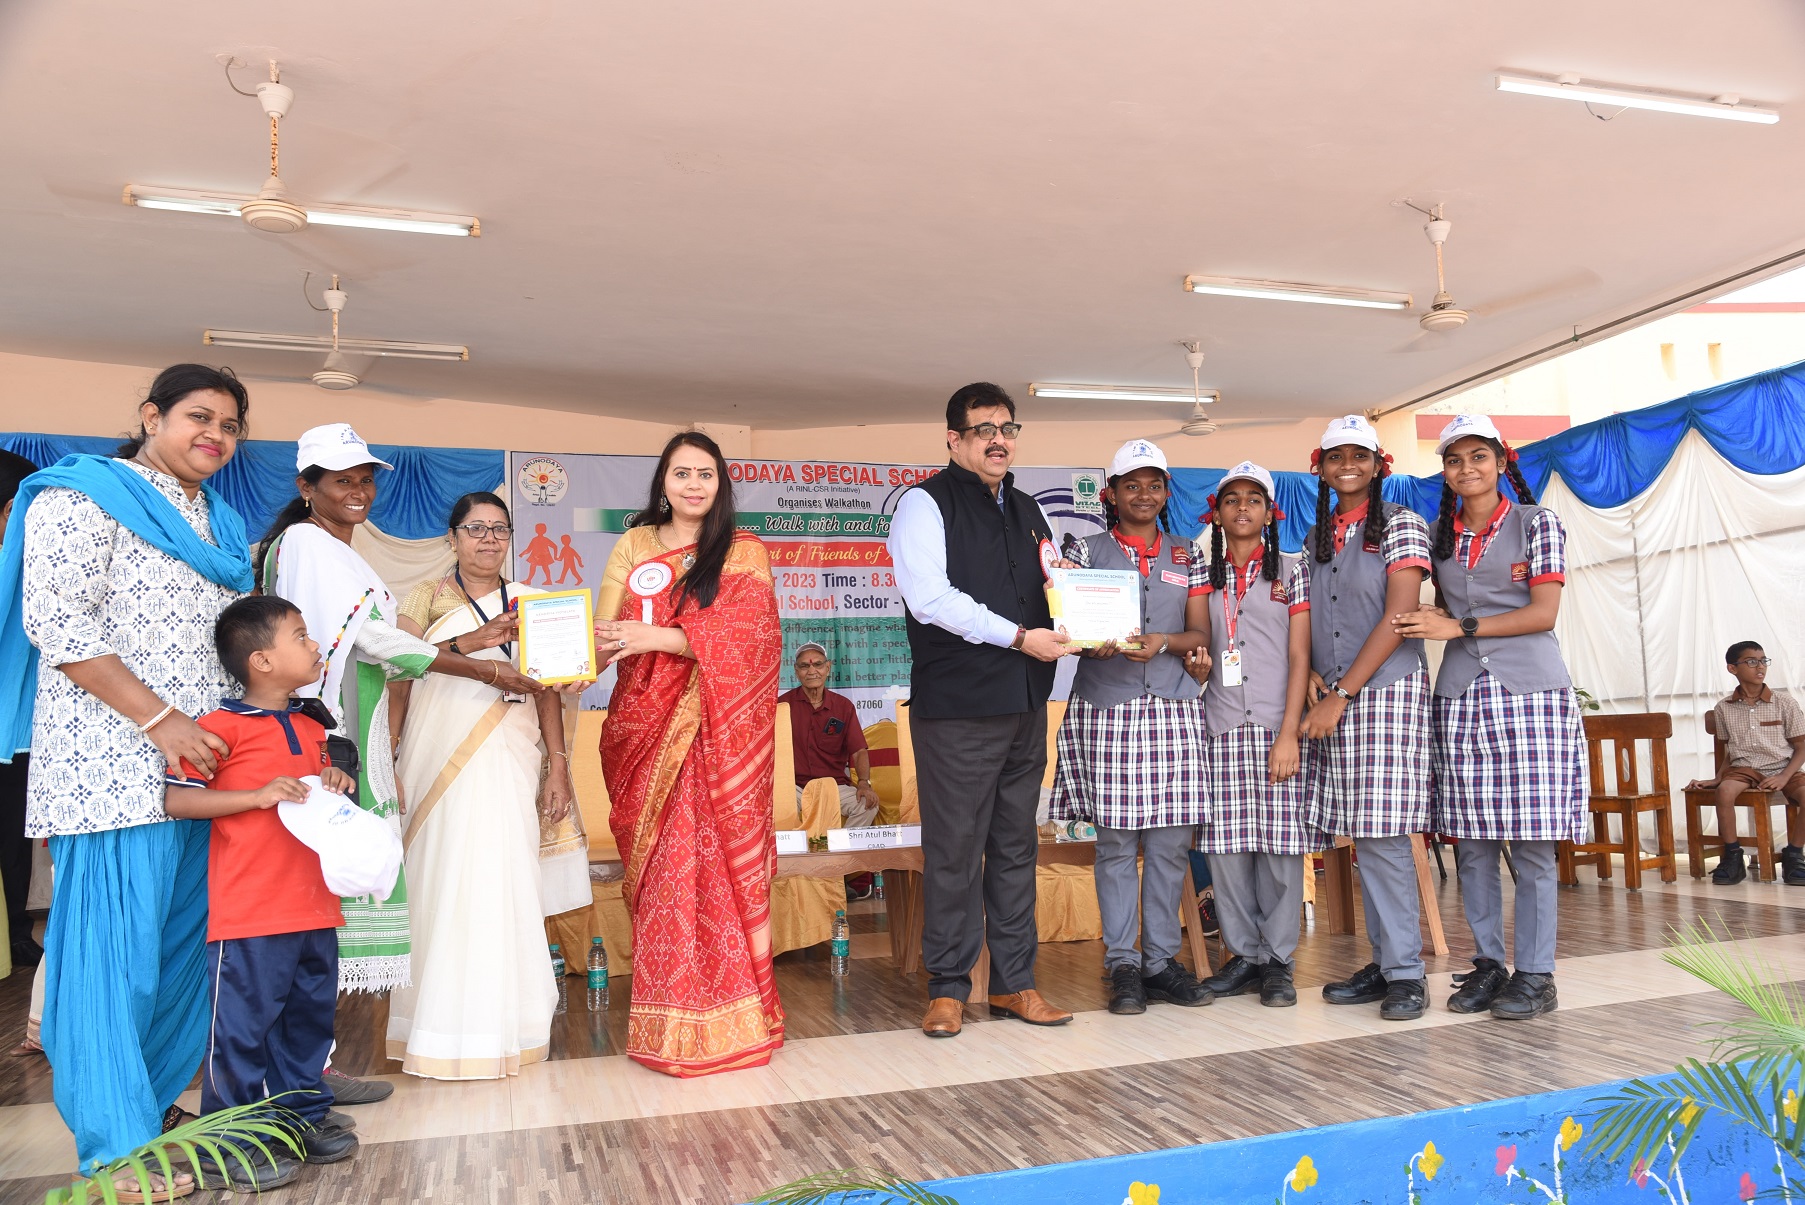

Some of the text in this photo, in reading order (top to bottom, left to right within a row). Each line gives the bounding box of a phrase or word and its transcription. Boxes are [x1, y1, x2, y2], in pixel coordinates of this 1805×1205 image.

[522, 458, 564, 474] ARUNODAYA
[727, 462, 942, 487] ODAYA SPECIAL SCH
[795, 485, 829, 493] RINL-CSR
[830, 485, 861, 495] Initiative)
[777, 497, 871, 510] Organises Walkathon
[765, 515, 804, 532] Walk
[808, 515, 839, 532] with
[844, 515, 872, 532] and
[875, 517, 890, 535] fo
[785, 544, 806, 564] of
[810, 544, 862, 562] Friends
[864, 545, 885, 564] of
[782, 572, 817, 588] 2023
[822, 573, 857, 588] Time
[788, 594, 839, 612] School,
[843, 593, 890, 609] Sector
[784, 621, 907, 635] difference, imagine wha
[845, 639, 868, 649] with
[882, 640, 909, 652] speci
[782, 654, 796, 666] ith
[841, 654, 864, 665] that
[865, 657, 885, 665] our
[888, 653, 913, 664] little
[827, 671, 841, 682] rld
[855, 672, 887, 682] better
[890, 670, 911, 684] plac
[856, 700, 883, 709] 87060
[776, 833, 791, 841] hatt
[848, 830, 863, 840] Shri
[865, 830, 881, 839] Atul
